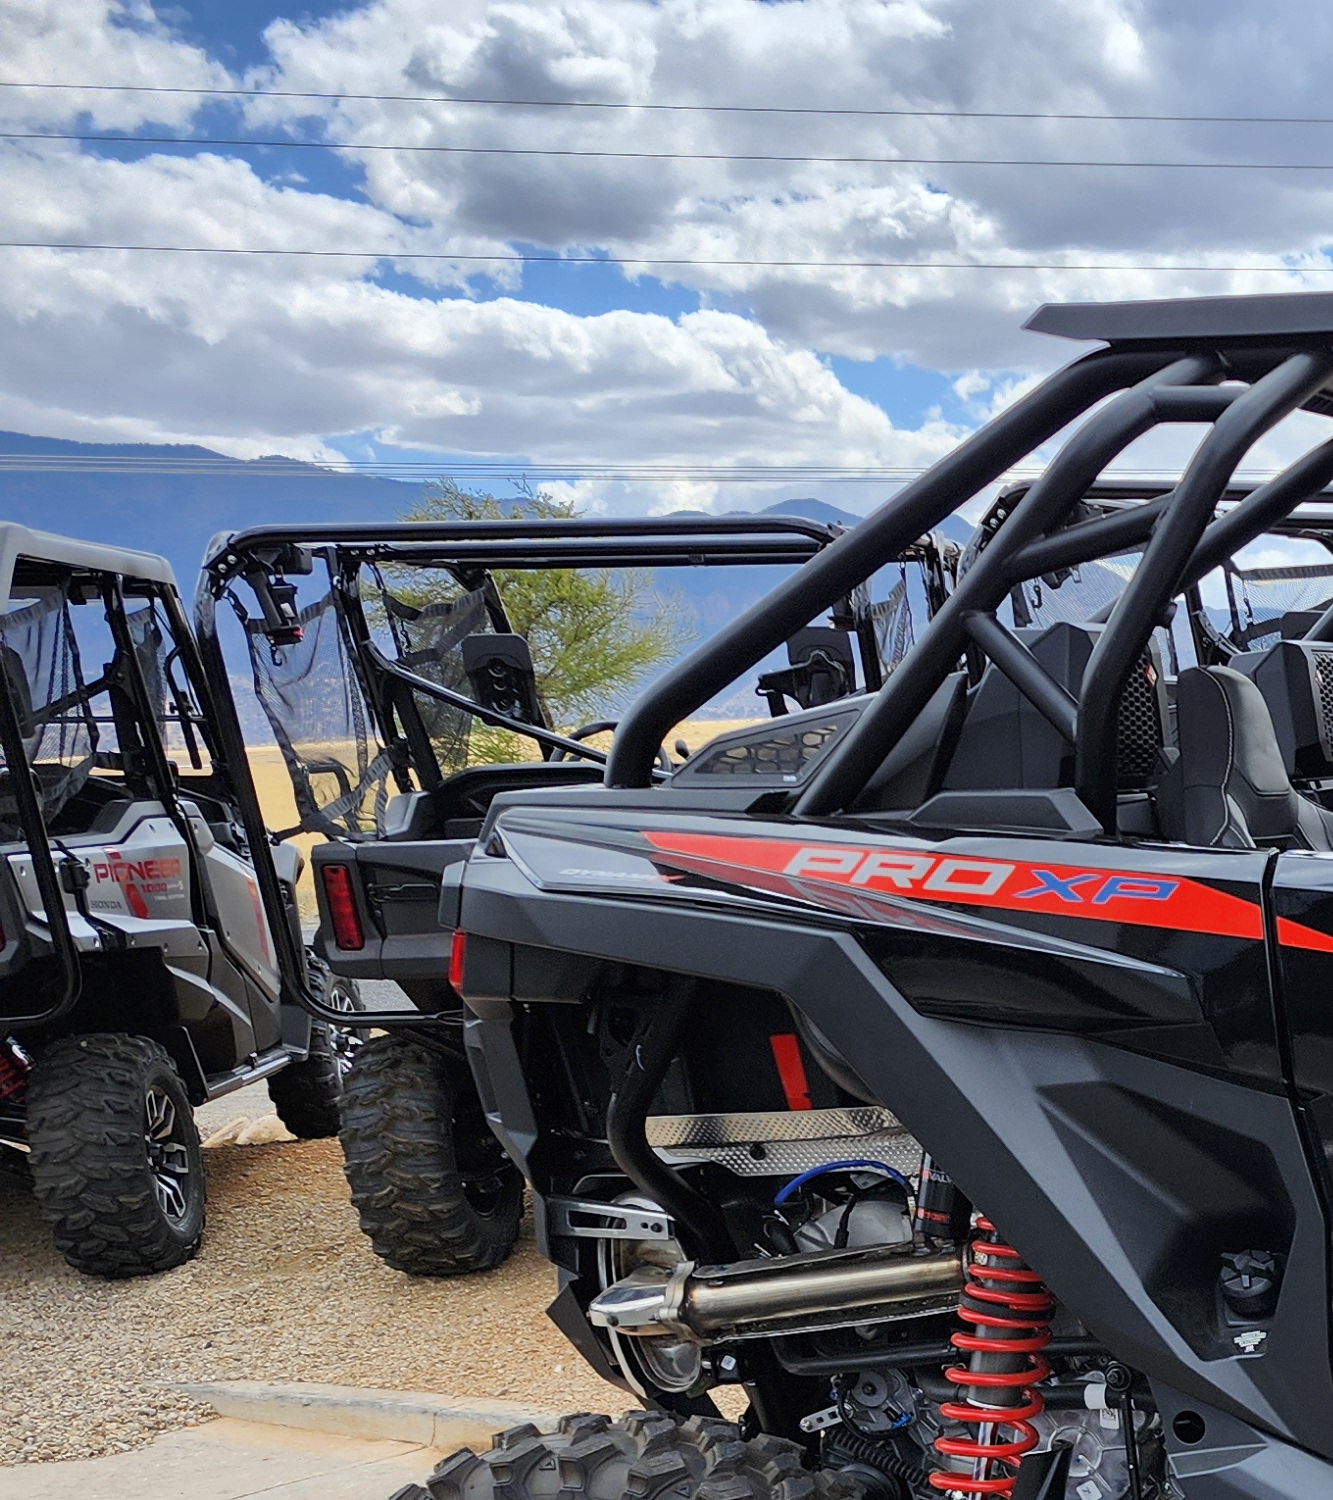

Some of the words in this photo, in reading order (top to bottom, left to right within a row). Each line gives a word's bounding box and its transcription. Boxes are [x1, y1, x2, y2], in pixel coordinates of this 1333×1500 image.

[93, 858, 181, 883] PIONEER
[782, 847, 1017, 896] PRO
[1012, 869, 1181, 905] XP
[91, 900, 122, 910] HONDA
